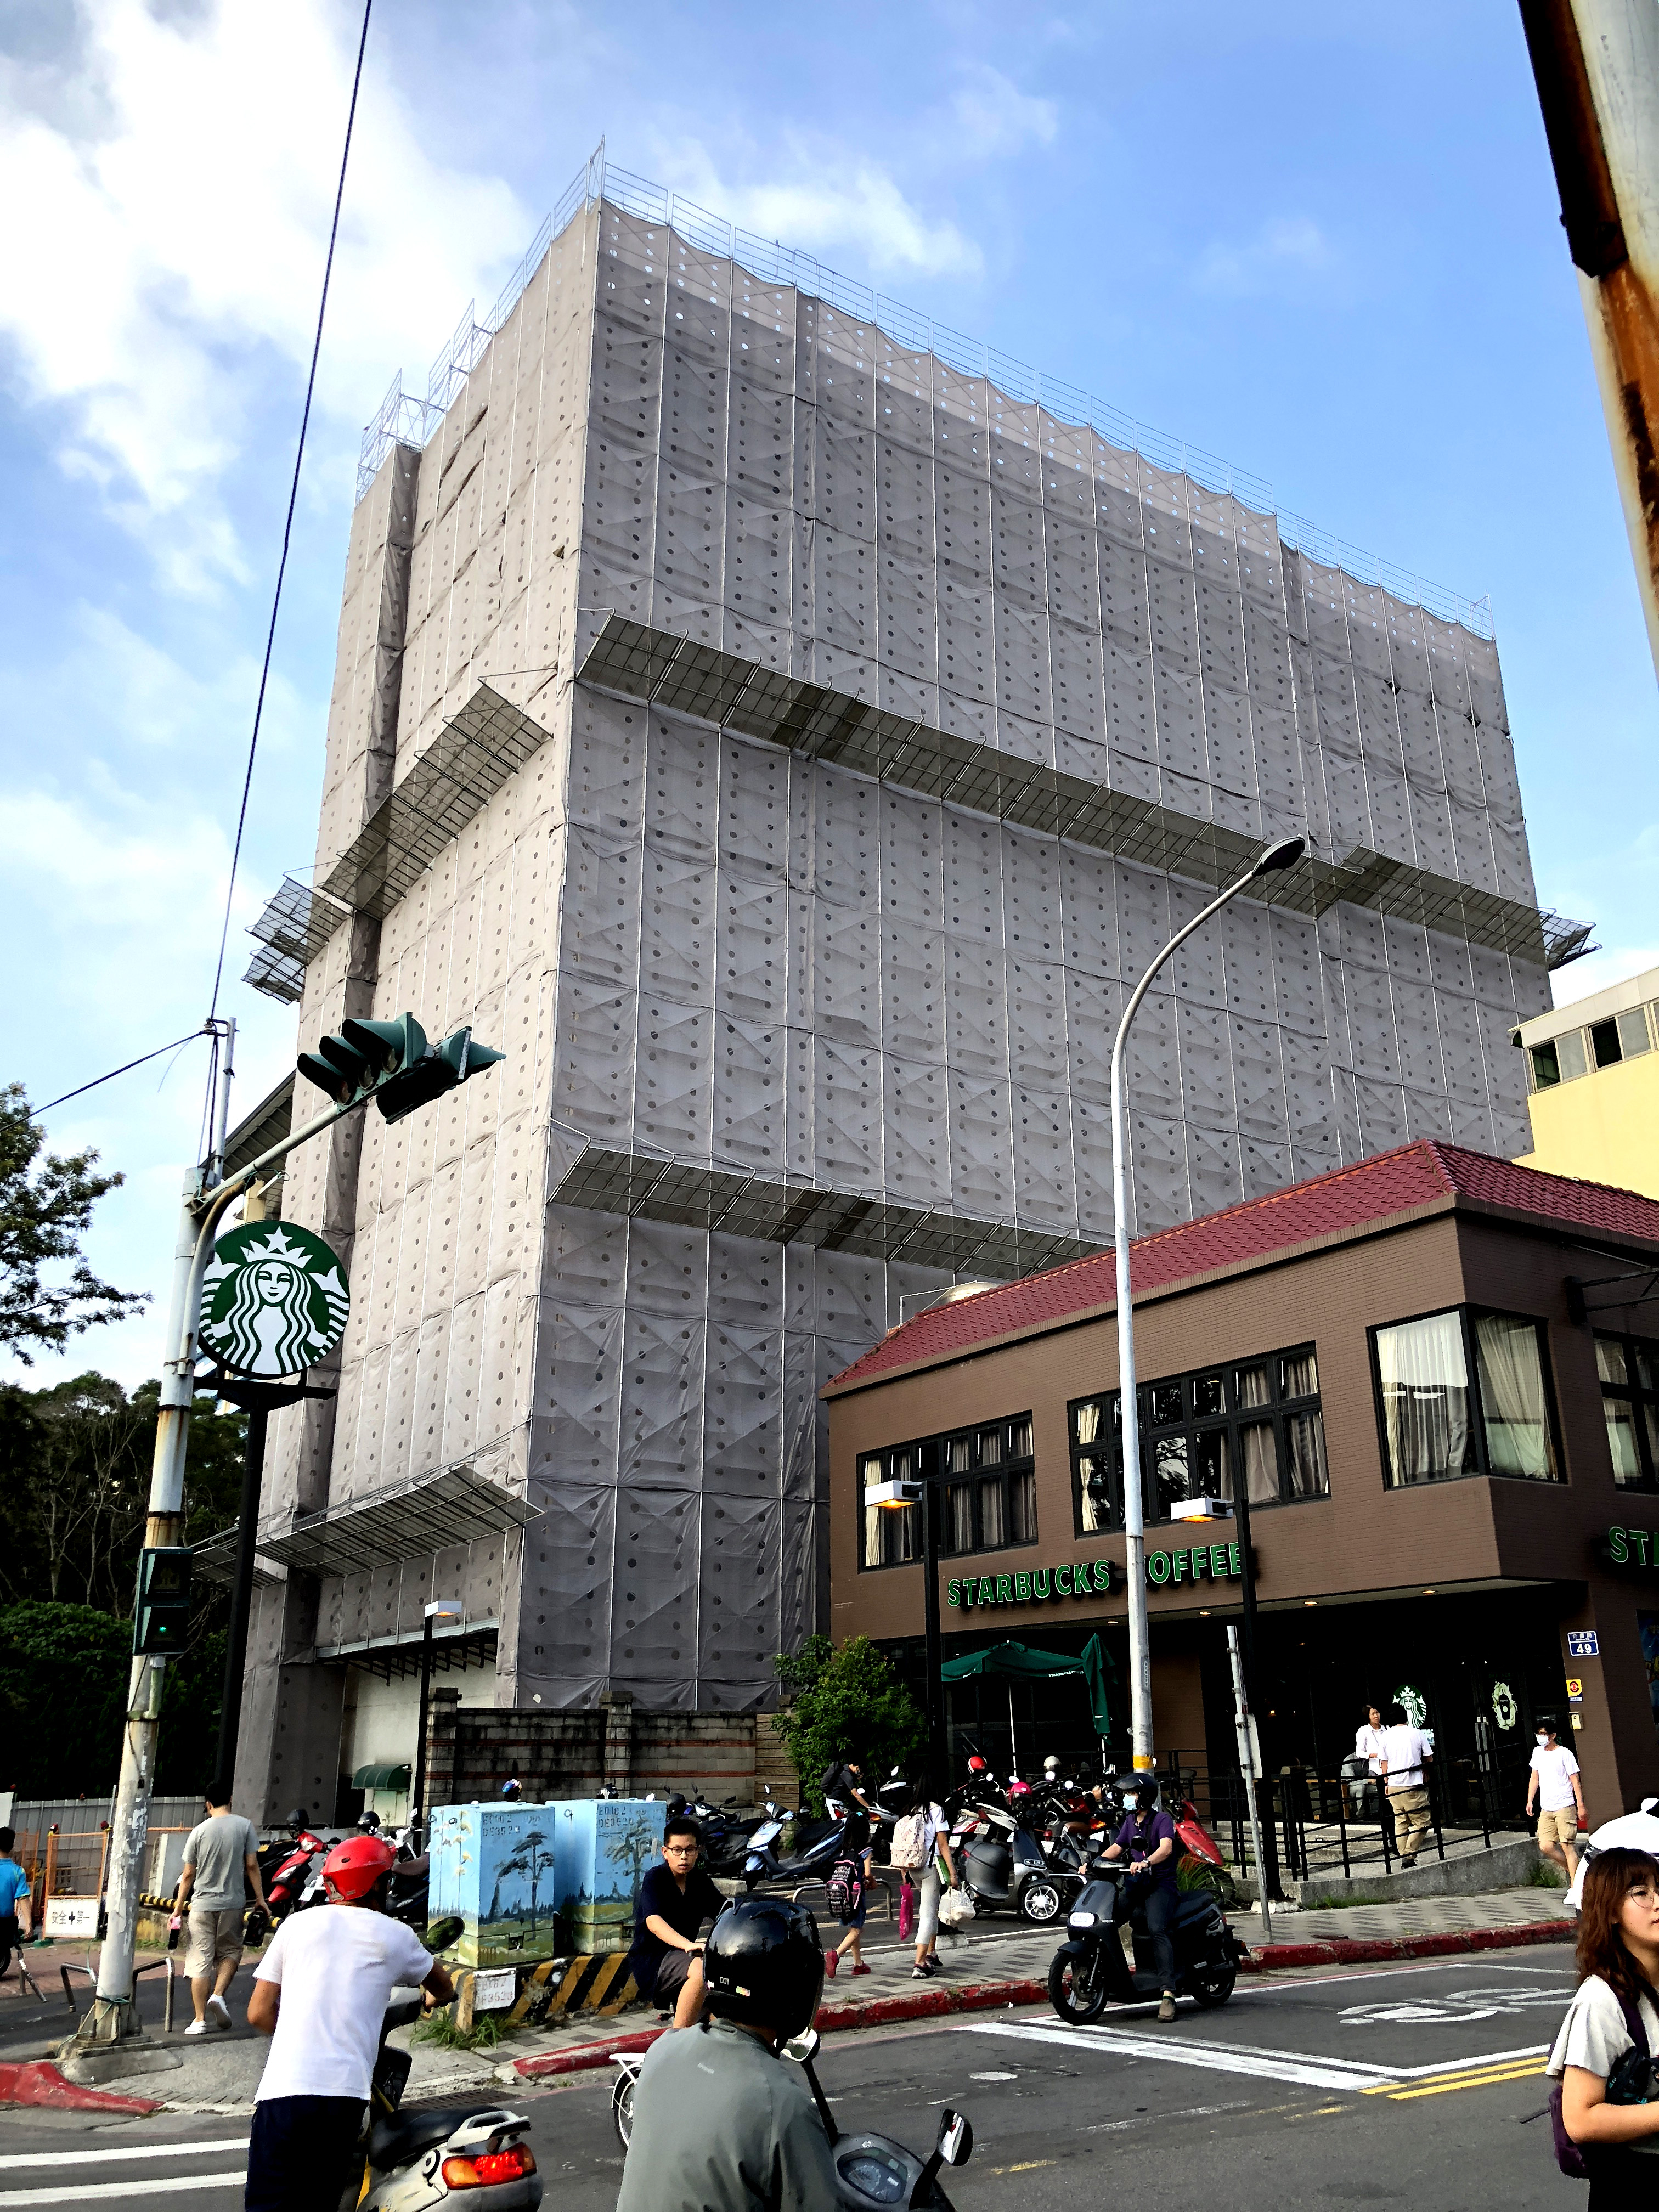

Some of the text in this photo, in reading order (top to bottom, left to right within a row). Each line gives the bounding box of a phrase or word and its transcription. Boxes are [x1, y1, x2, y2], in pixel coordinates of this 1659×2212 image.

[947, 1542, 1242, 1607] STARBUCKS OFFEE
[1577, 1644, 1592, 1654] 49
[720, 1976, 730, 1985] DOT
